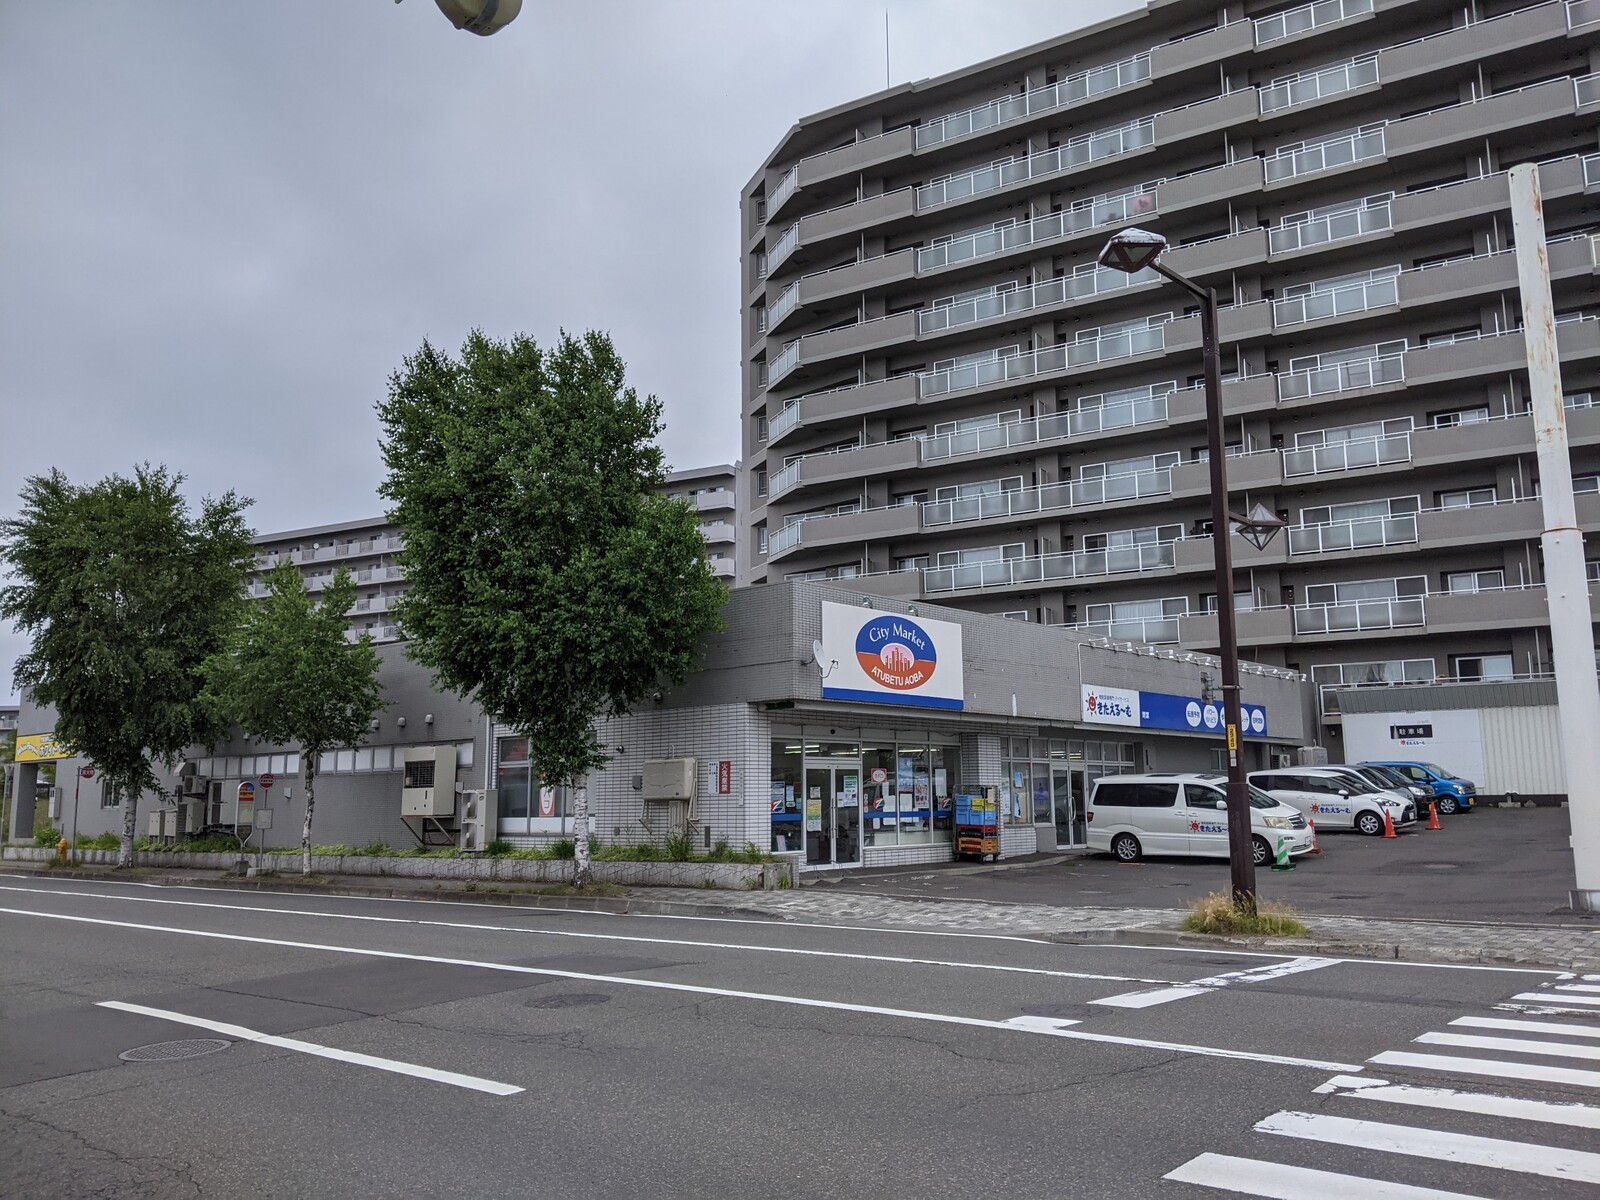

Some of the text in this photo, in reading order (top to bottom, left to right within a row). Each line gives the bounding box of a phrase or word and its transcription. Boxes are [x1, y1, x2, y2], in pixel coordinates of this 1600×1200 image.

[869, 622, 926, 651] City Market
[871, 666, 924, 686] ATUBETU AOBA
